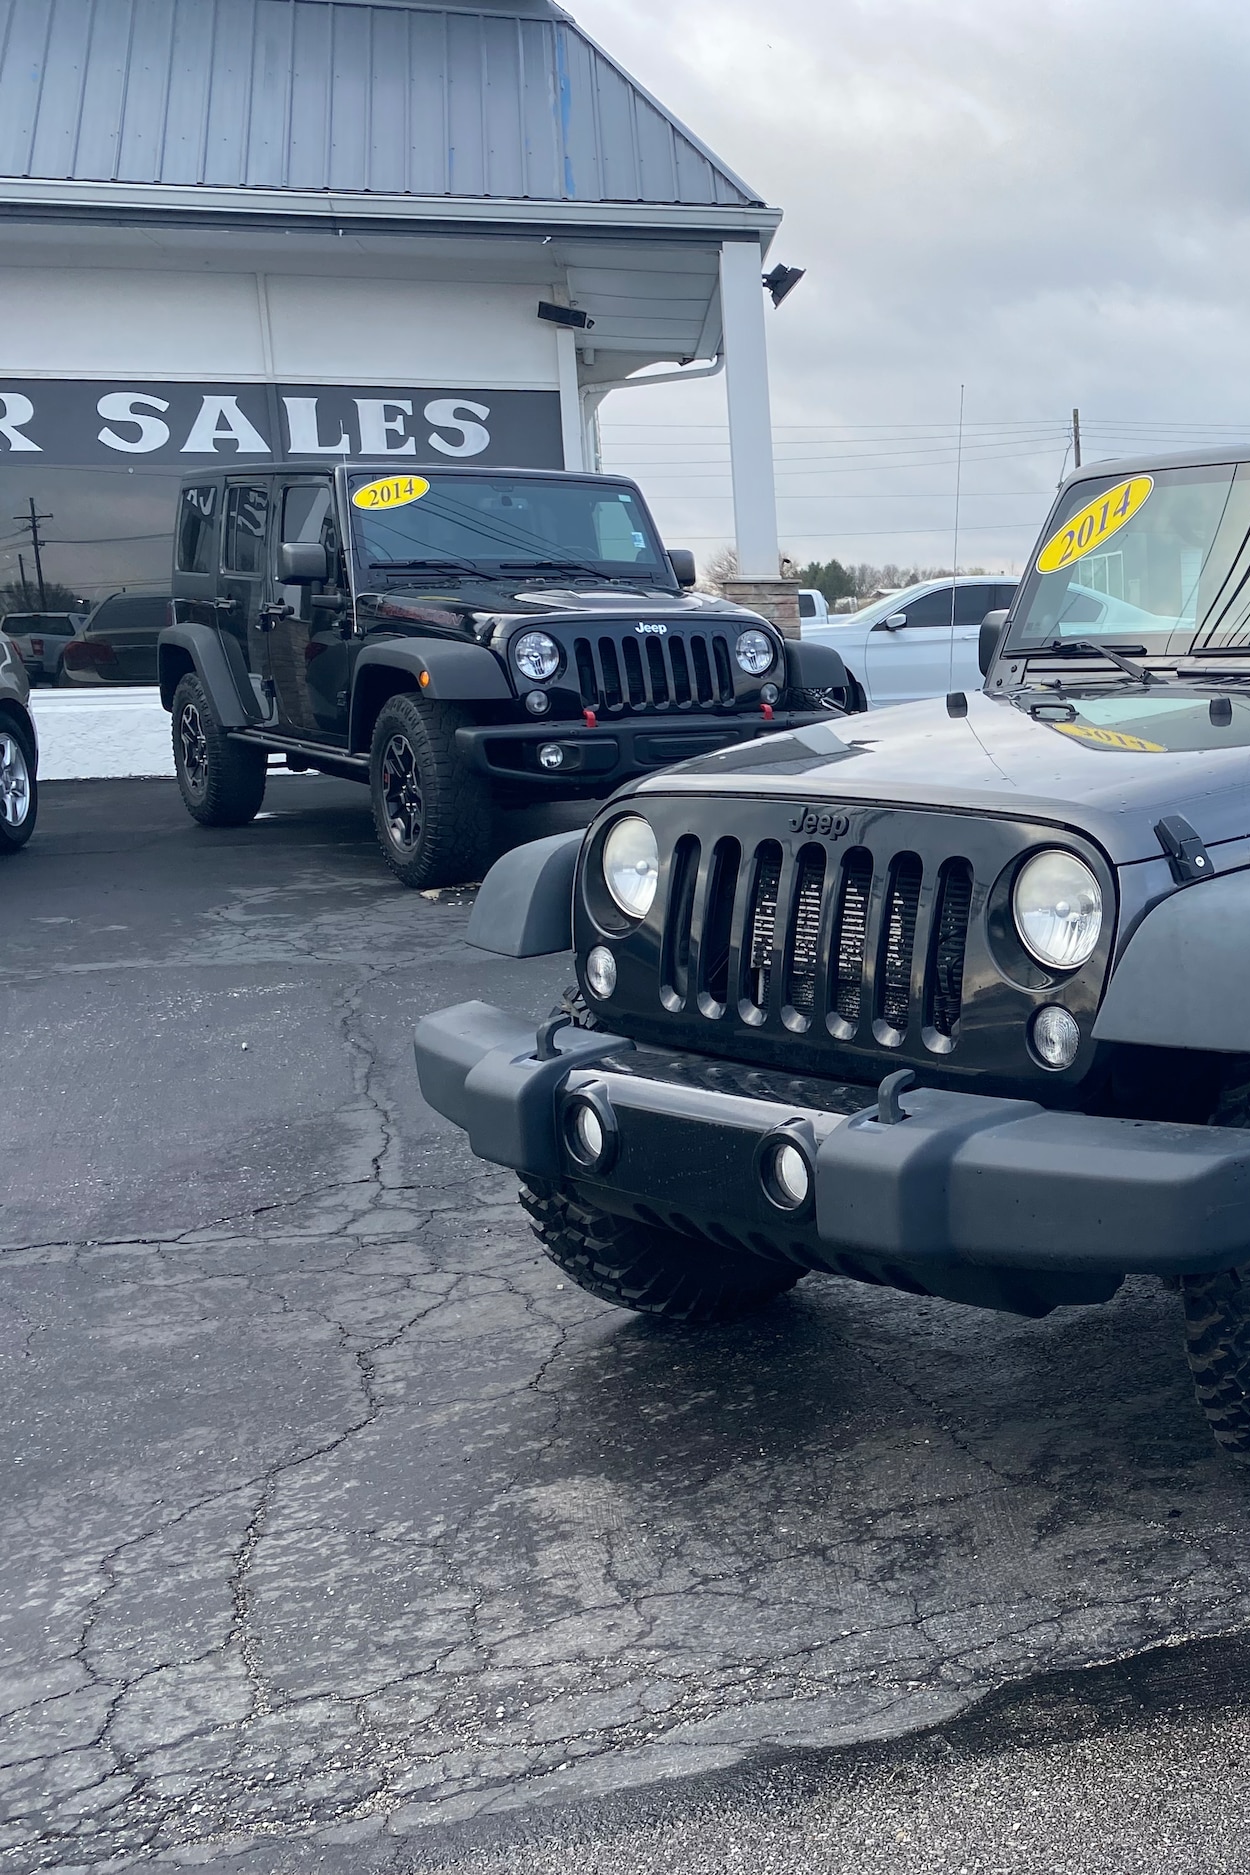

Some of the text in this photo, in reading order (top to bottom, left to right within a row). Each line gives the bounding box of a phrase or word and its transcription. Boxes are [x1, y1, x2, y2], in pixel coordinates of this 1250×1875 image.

[97, 391, 491, 458] SALES
[368, 478, 414, 506] 2014
[1058, 483, 1132, 566] 2014
[634, 621, 667, 635] Jeep
[788, 806, 849, 841] Jeep
